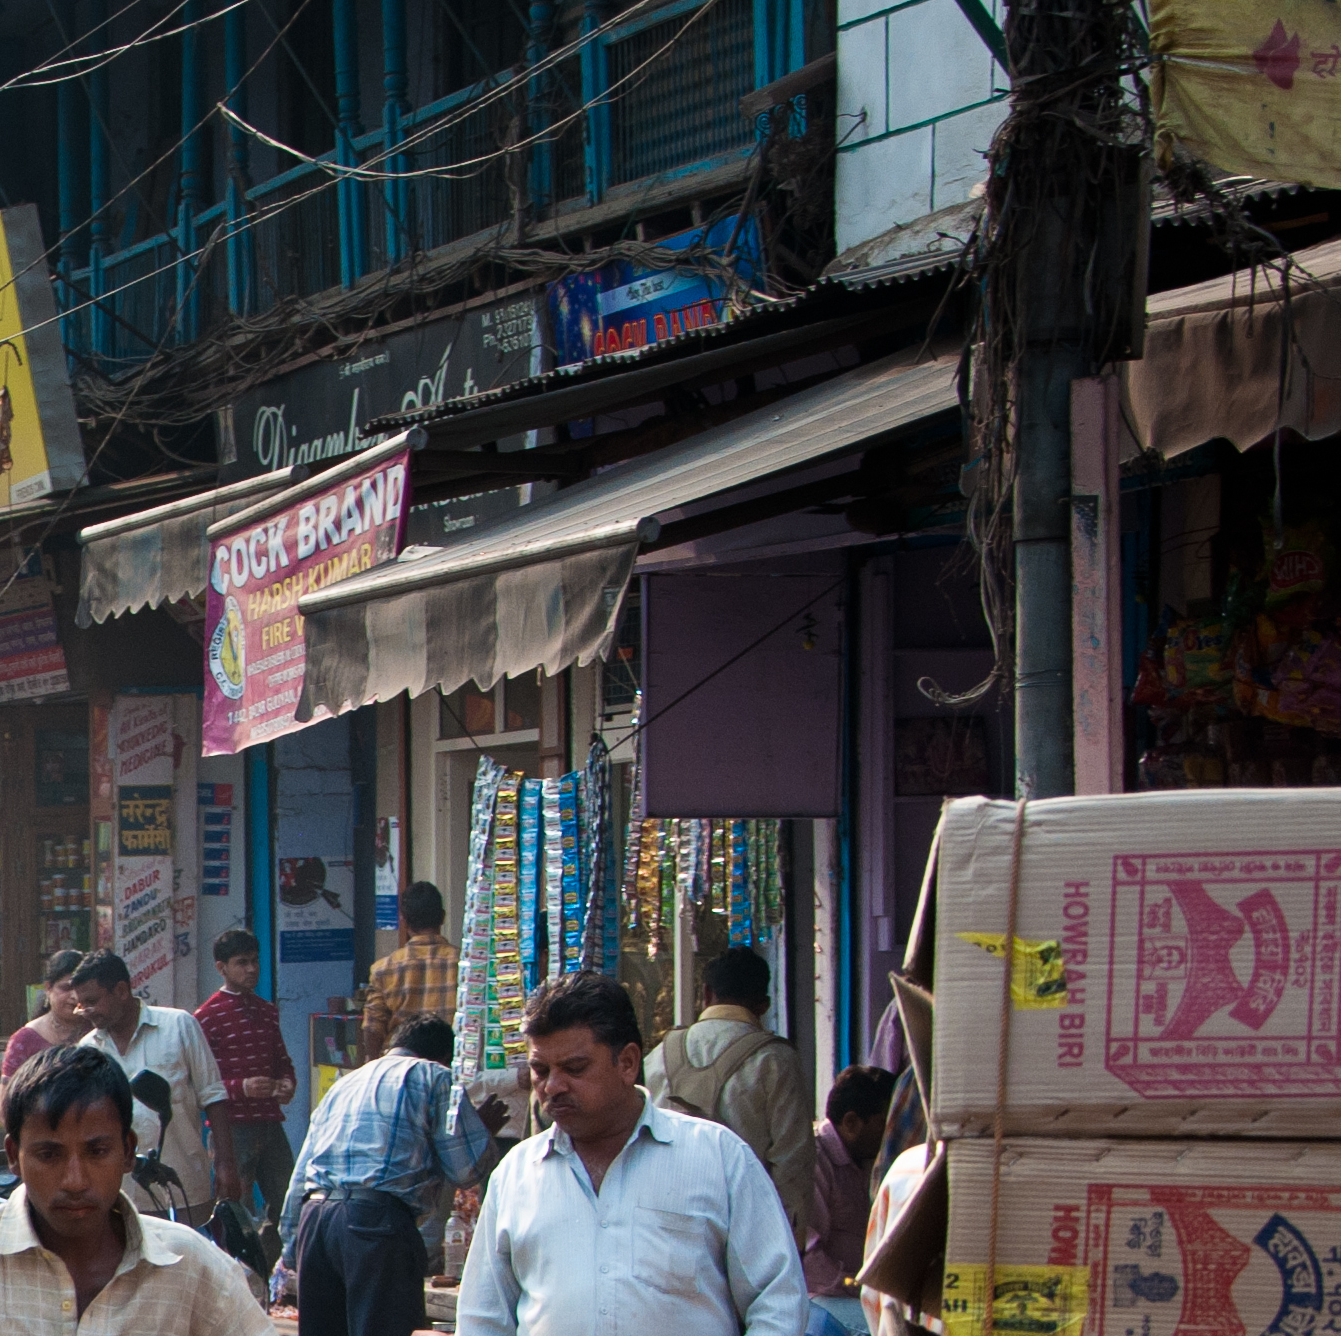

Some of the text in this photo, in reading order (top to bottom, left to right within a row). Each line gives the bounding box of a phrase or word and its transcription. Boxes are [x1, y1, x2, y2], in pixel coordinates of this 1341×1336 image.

[210, 463, 406, 596] COCK BRAND
[247, 575, 305, 622] HARSH
[262, 619, 292, 651] FIRE
[123, 887, 158, 919] ZANDU
[124, 869, 161, 900] DABUR
[1057, 880, 1090, 1069] HOWRAH BIRI
